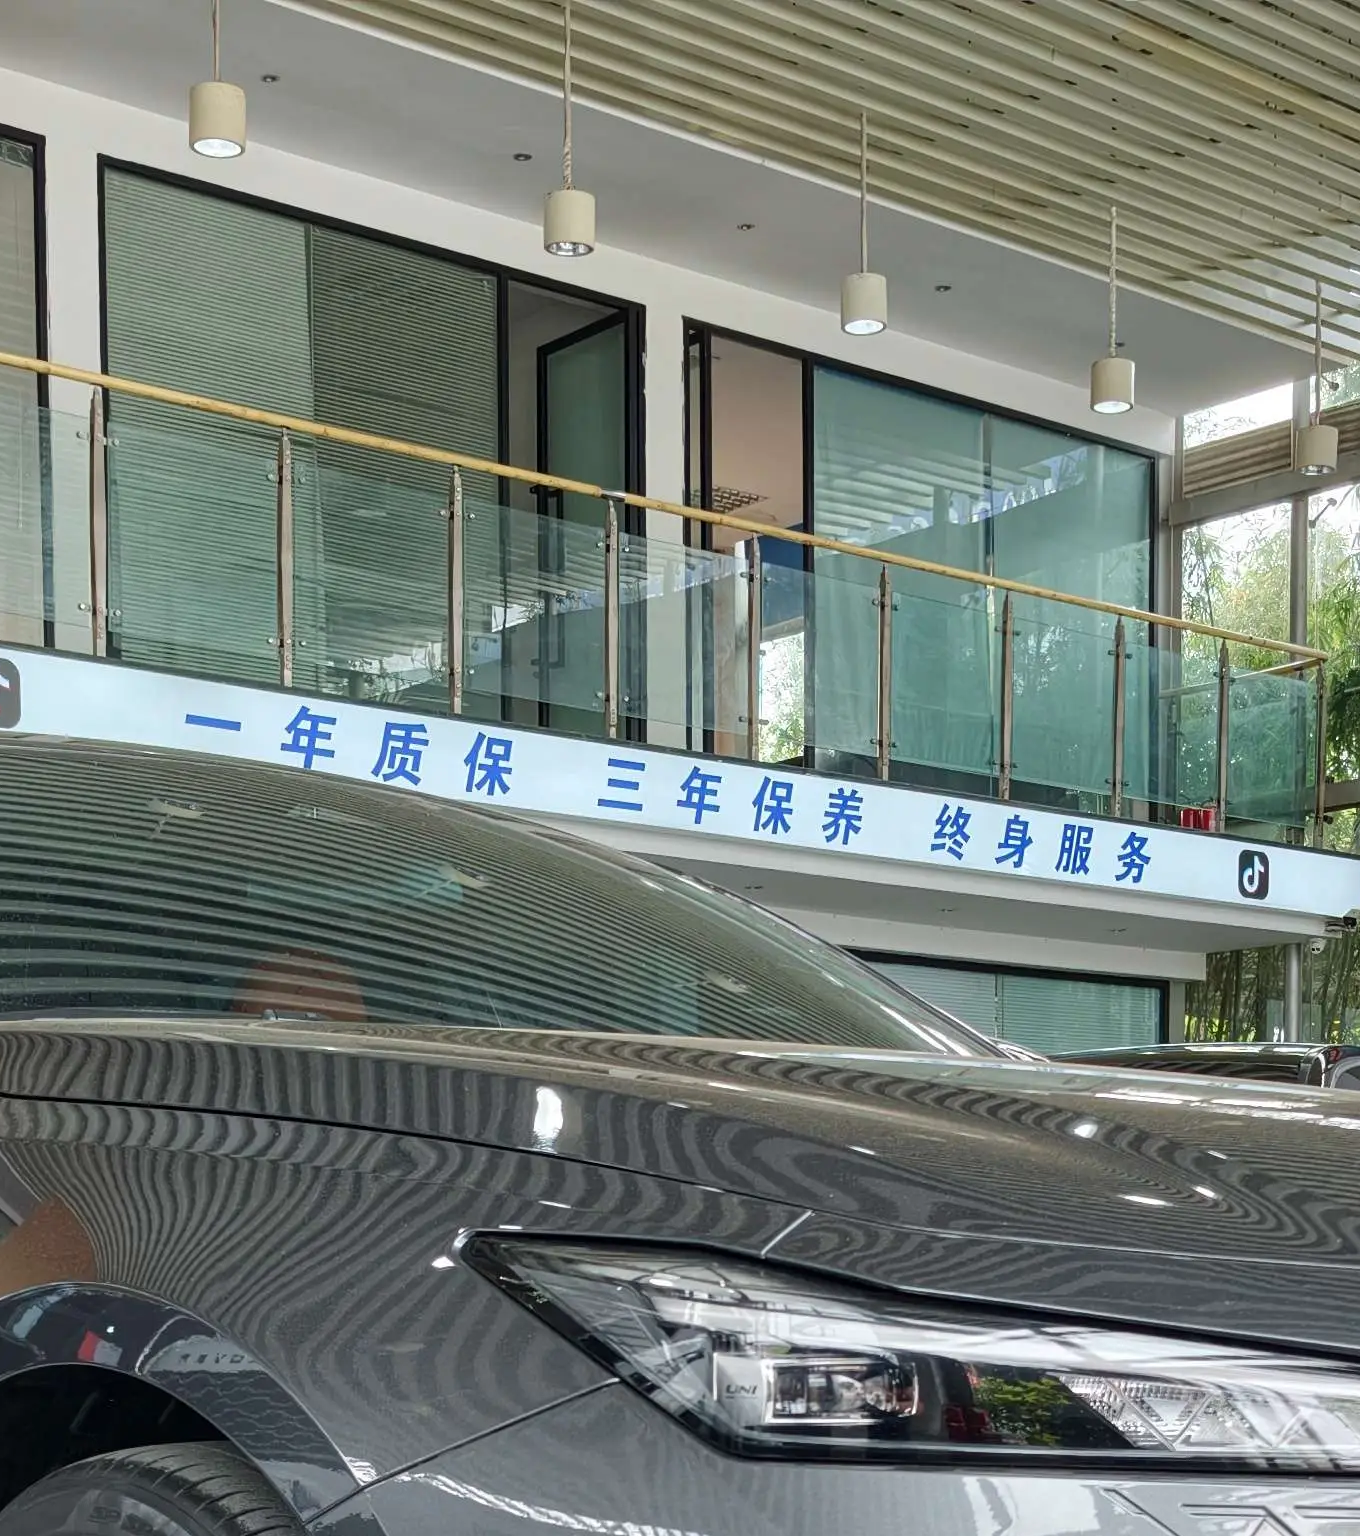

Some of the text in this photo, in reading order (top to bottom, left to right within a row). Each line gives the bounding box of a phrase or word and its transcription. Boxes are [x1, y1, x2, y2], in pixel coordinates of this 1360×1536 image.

[185, 704, 1152, 884] 一年质保 三年保养 终身服务
[726, 1384, 758, 1394] UNI
